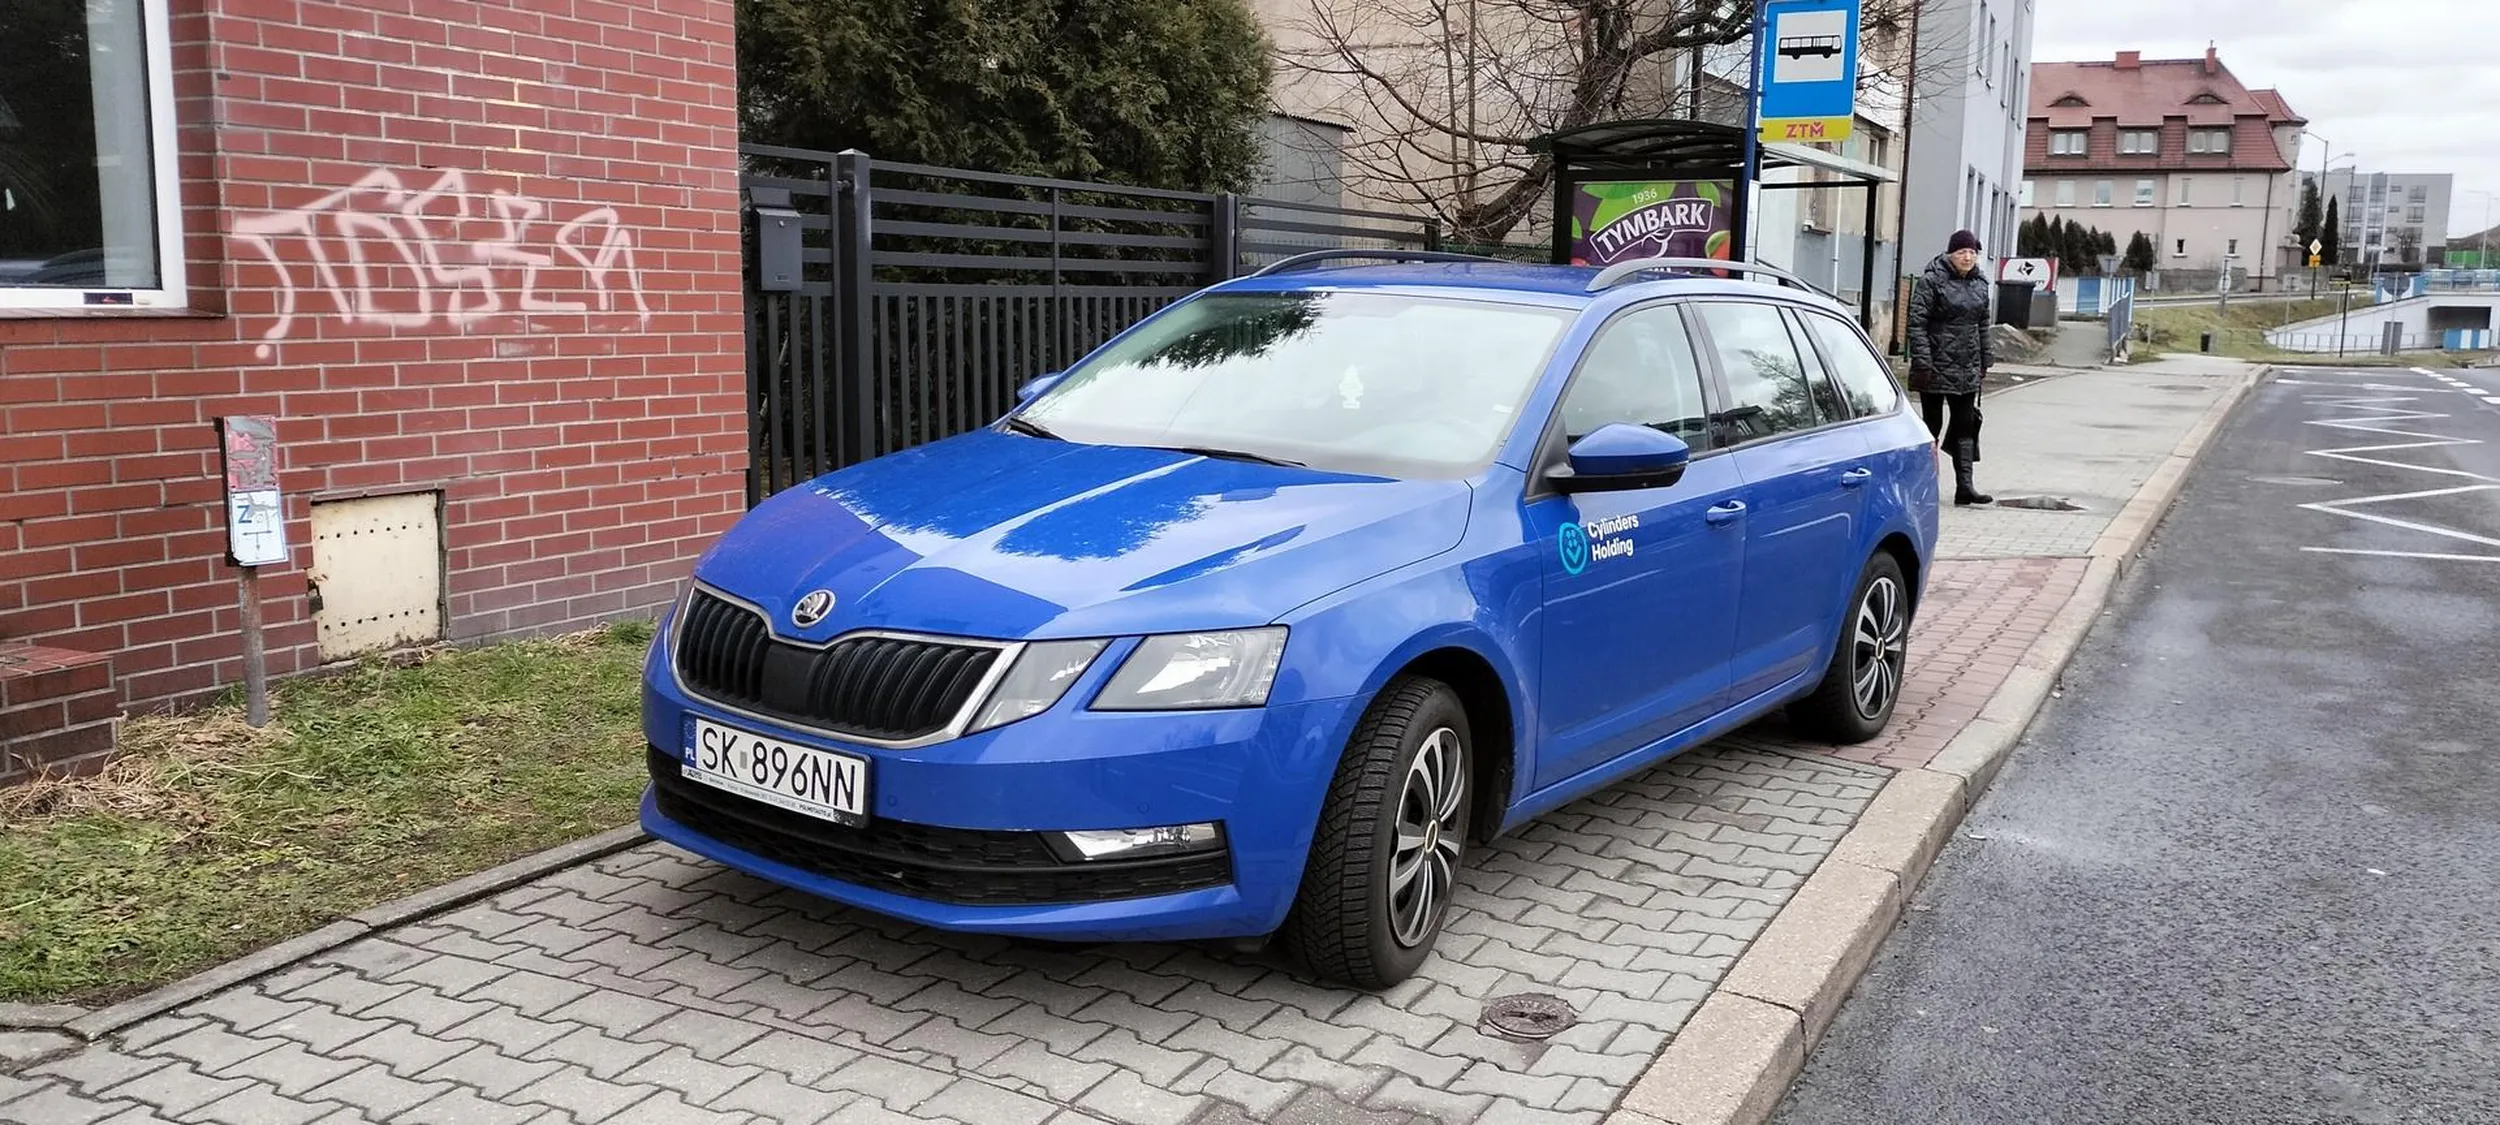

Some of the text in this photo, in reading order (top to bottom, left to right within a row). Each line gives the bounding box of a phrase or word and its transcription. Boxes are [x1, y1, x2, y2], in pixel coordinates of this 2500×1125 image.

[1786, 122, 1825, 138] ZTM
[1632, 188, 1658, 205] 1936
[1597, 203, 1706, 253] TYMBARK
[1588, 515, 1640, 539] Cylinders
[1591, 540, 1634, 561] Holding
[684, 747, 696, 761] PL
[702, 727, 738, 778] SK
[752, 741, 856, 810] 896NN
